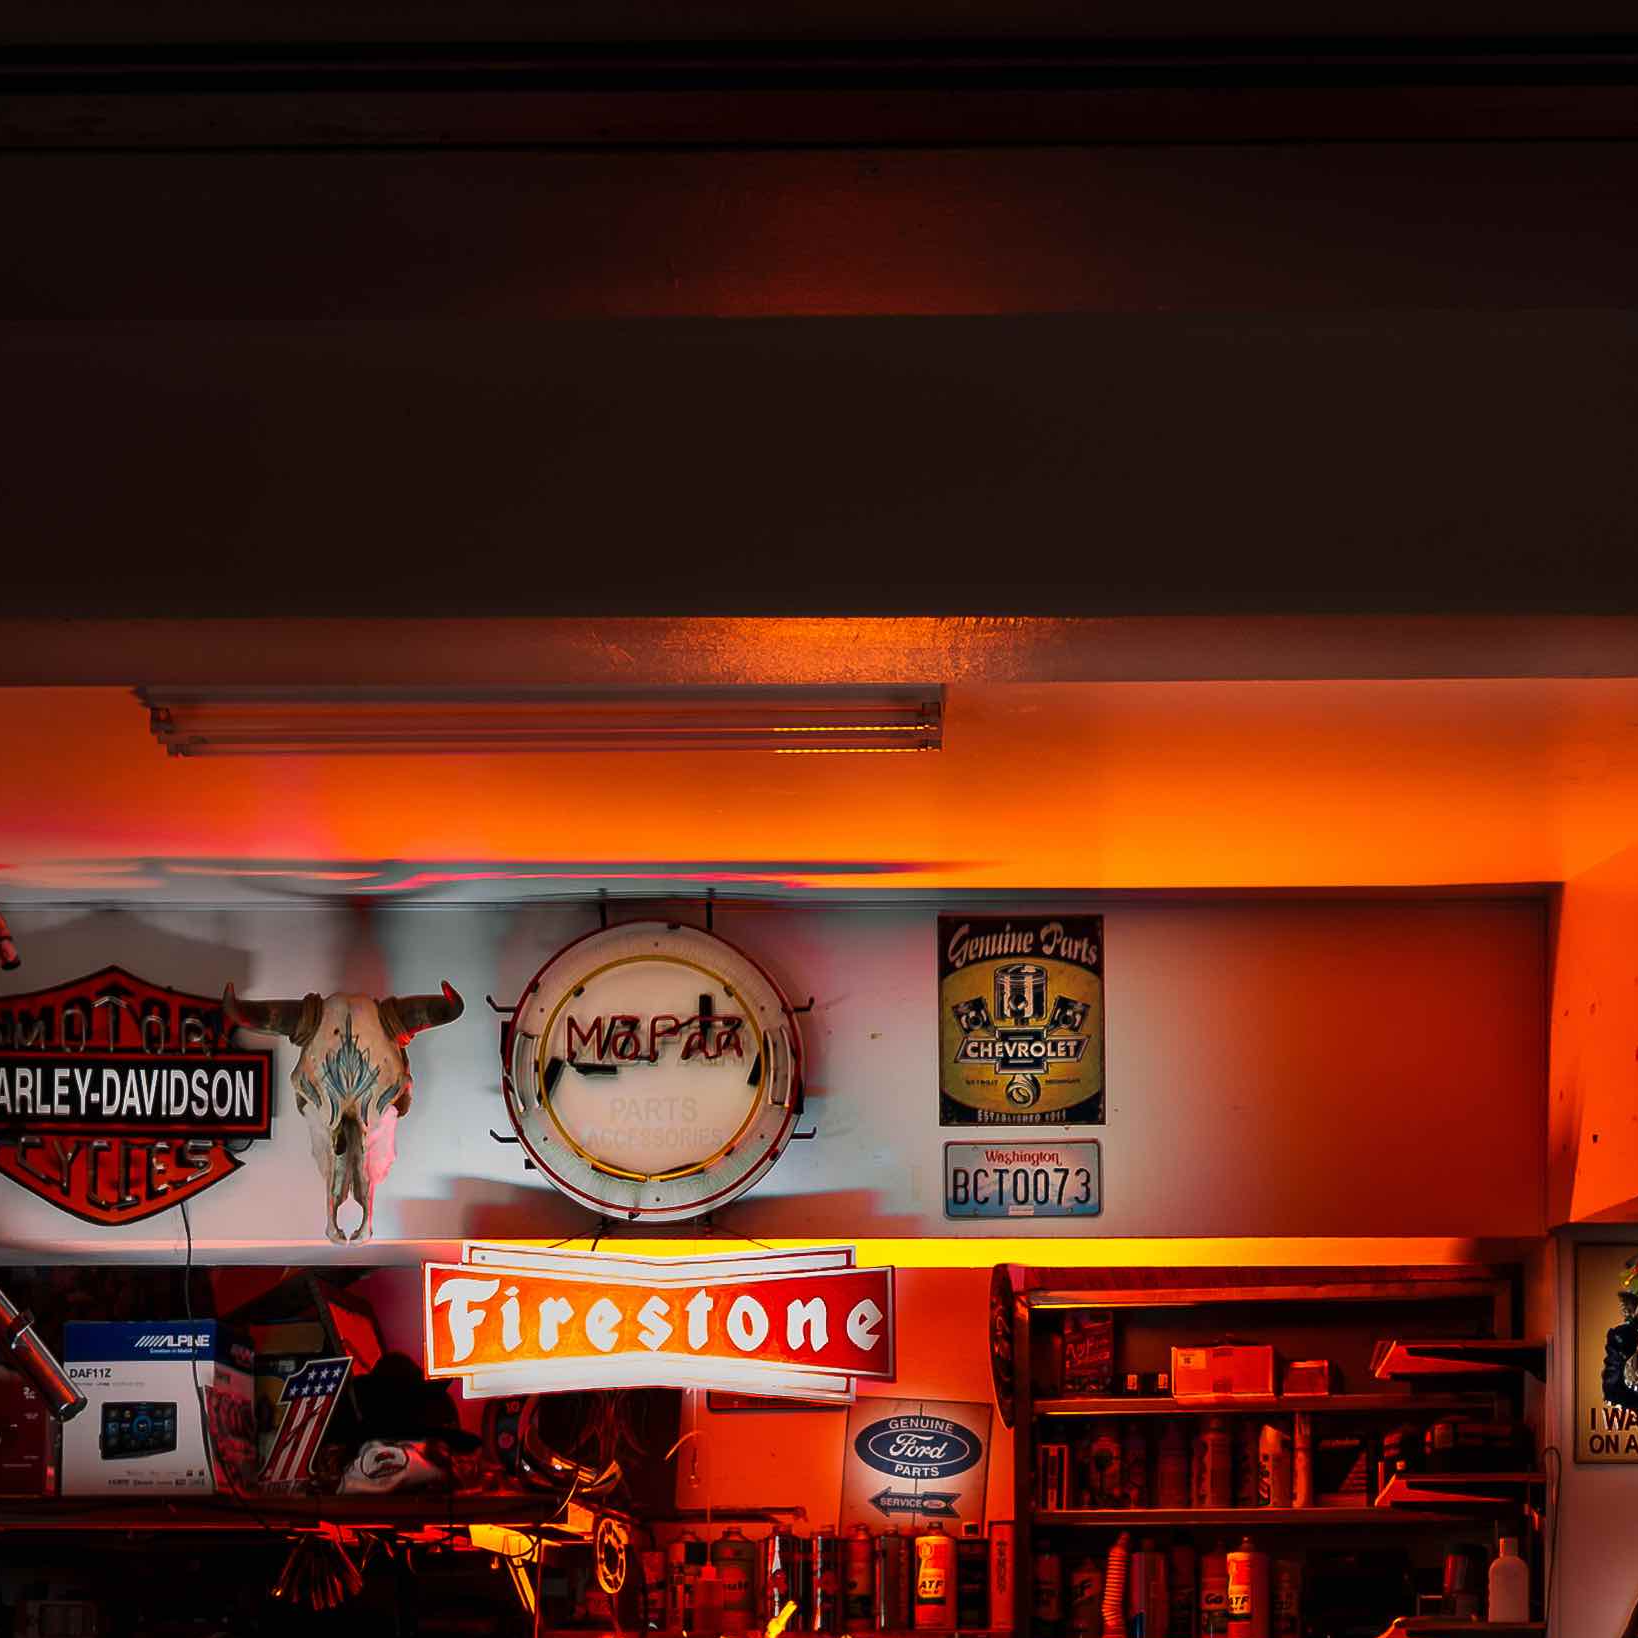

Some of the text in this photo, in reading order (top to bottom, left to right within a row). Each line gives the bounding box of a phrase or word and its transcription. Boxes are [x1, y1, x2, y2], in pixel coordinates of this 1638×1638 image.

[947, 920, 1099, 968] Genuine Parts
[5, 994, 222, 1057] MOTOR
[966, 1040, 1079, 1058] CHEVROLET
[611, 1098, 699, 1123] PARTS
[586, 1127, 723, 1150] ACCESSORIES
[984, 1150, 1063, 1167] Washington
[15, 1136, 215, 1210] CYCLES
[434, 1278, 885, 1363] Firestone
[160, 1335, 210, 1347] ALPINE
[70, 1367, 112, 1379] DAF11Z
[889, 1418, 955, 1433] GENUINE
[1590, 1407, 1596, 1430] I
[888, 1432, 949, 1460] Ford
[1589, 1434, 1619, 1454] ON
[894, 1463, 940, 1478] PARTS
[880, 1496, 923, 1509] SERVICE
